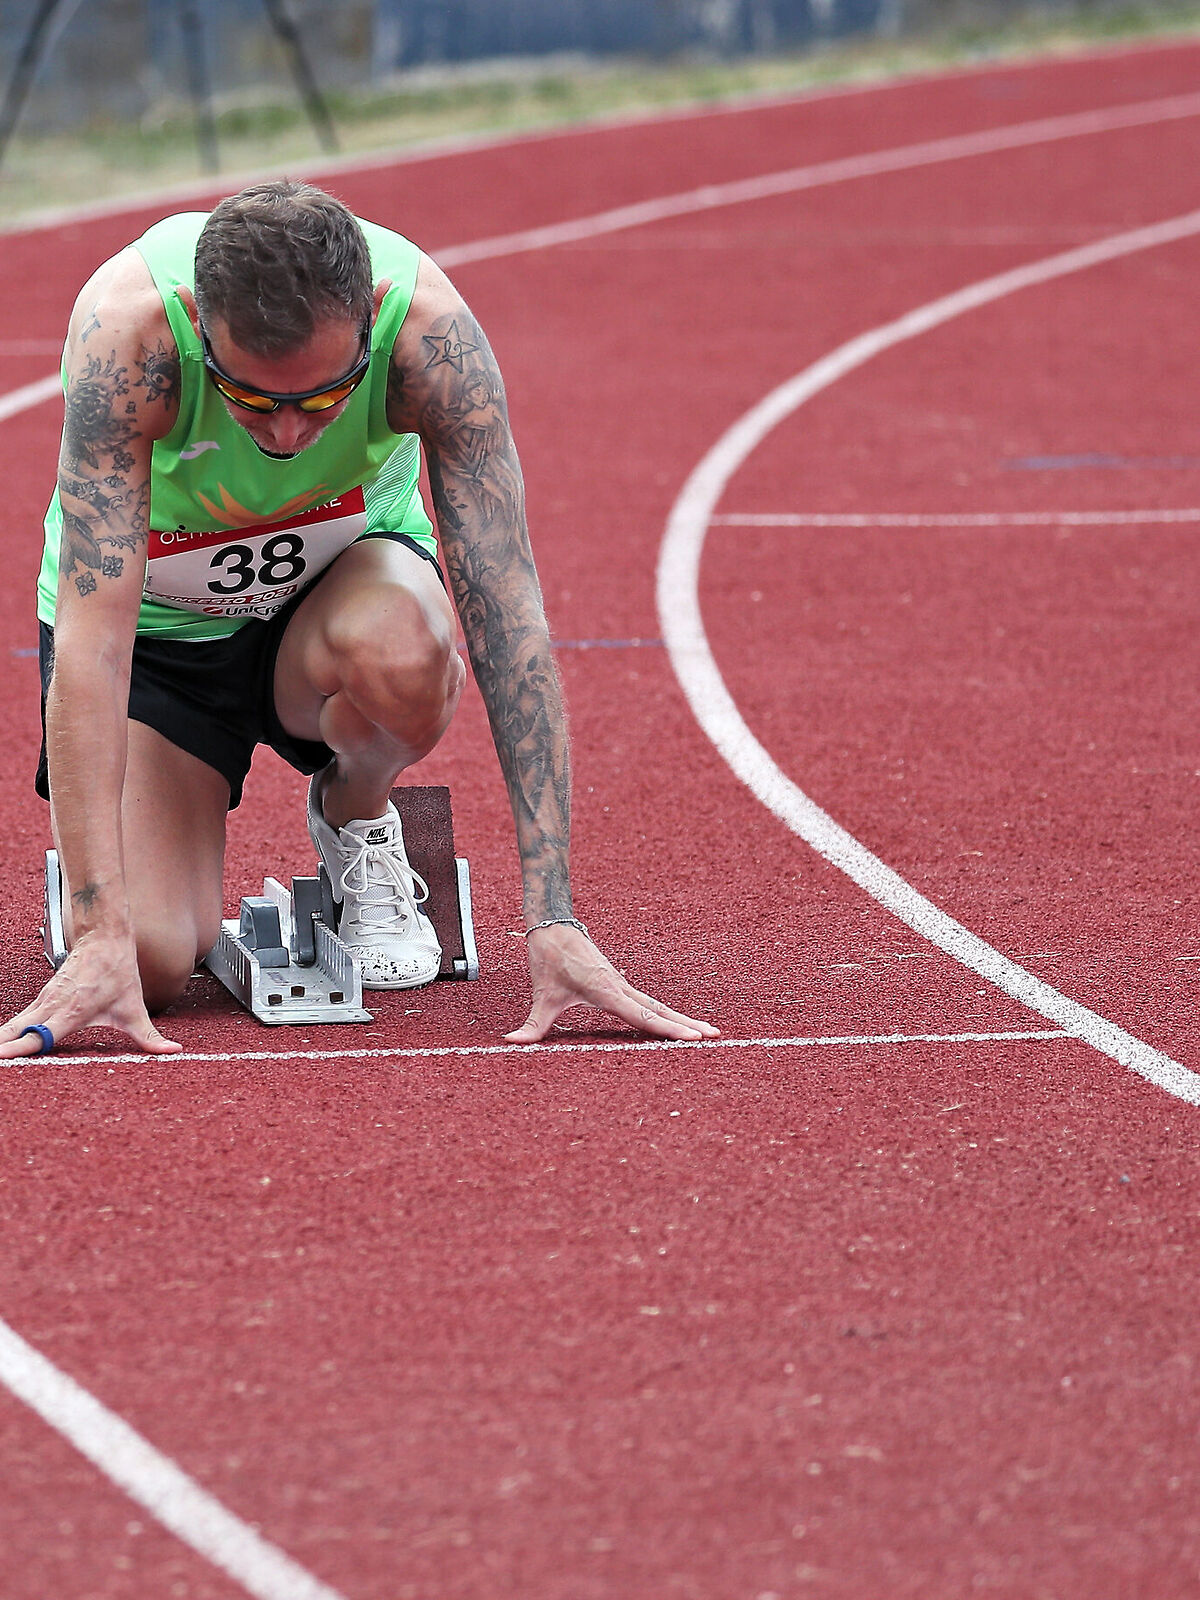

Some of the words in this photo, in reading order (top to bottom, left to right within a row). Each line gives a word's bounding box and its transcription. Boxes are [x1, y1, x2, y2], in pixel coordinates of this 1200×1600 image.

[207, 533, 307, 595] 38
[250, 586, 294, 603] 2021
[366, 826, 387, 839] NIKE
